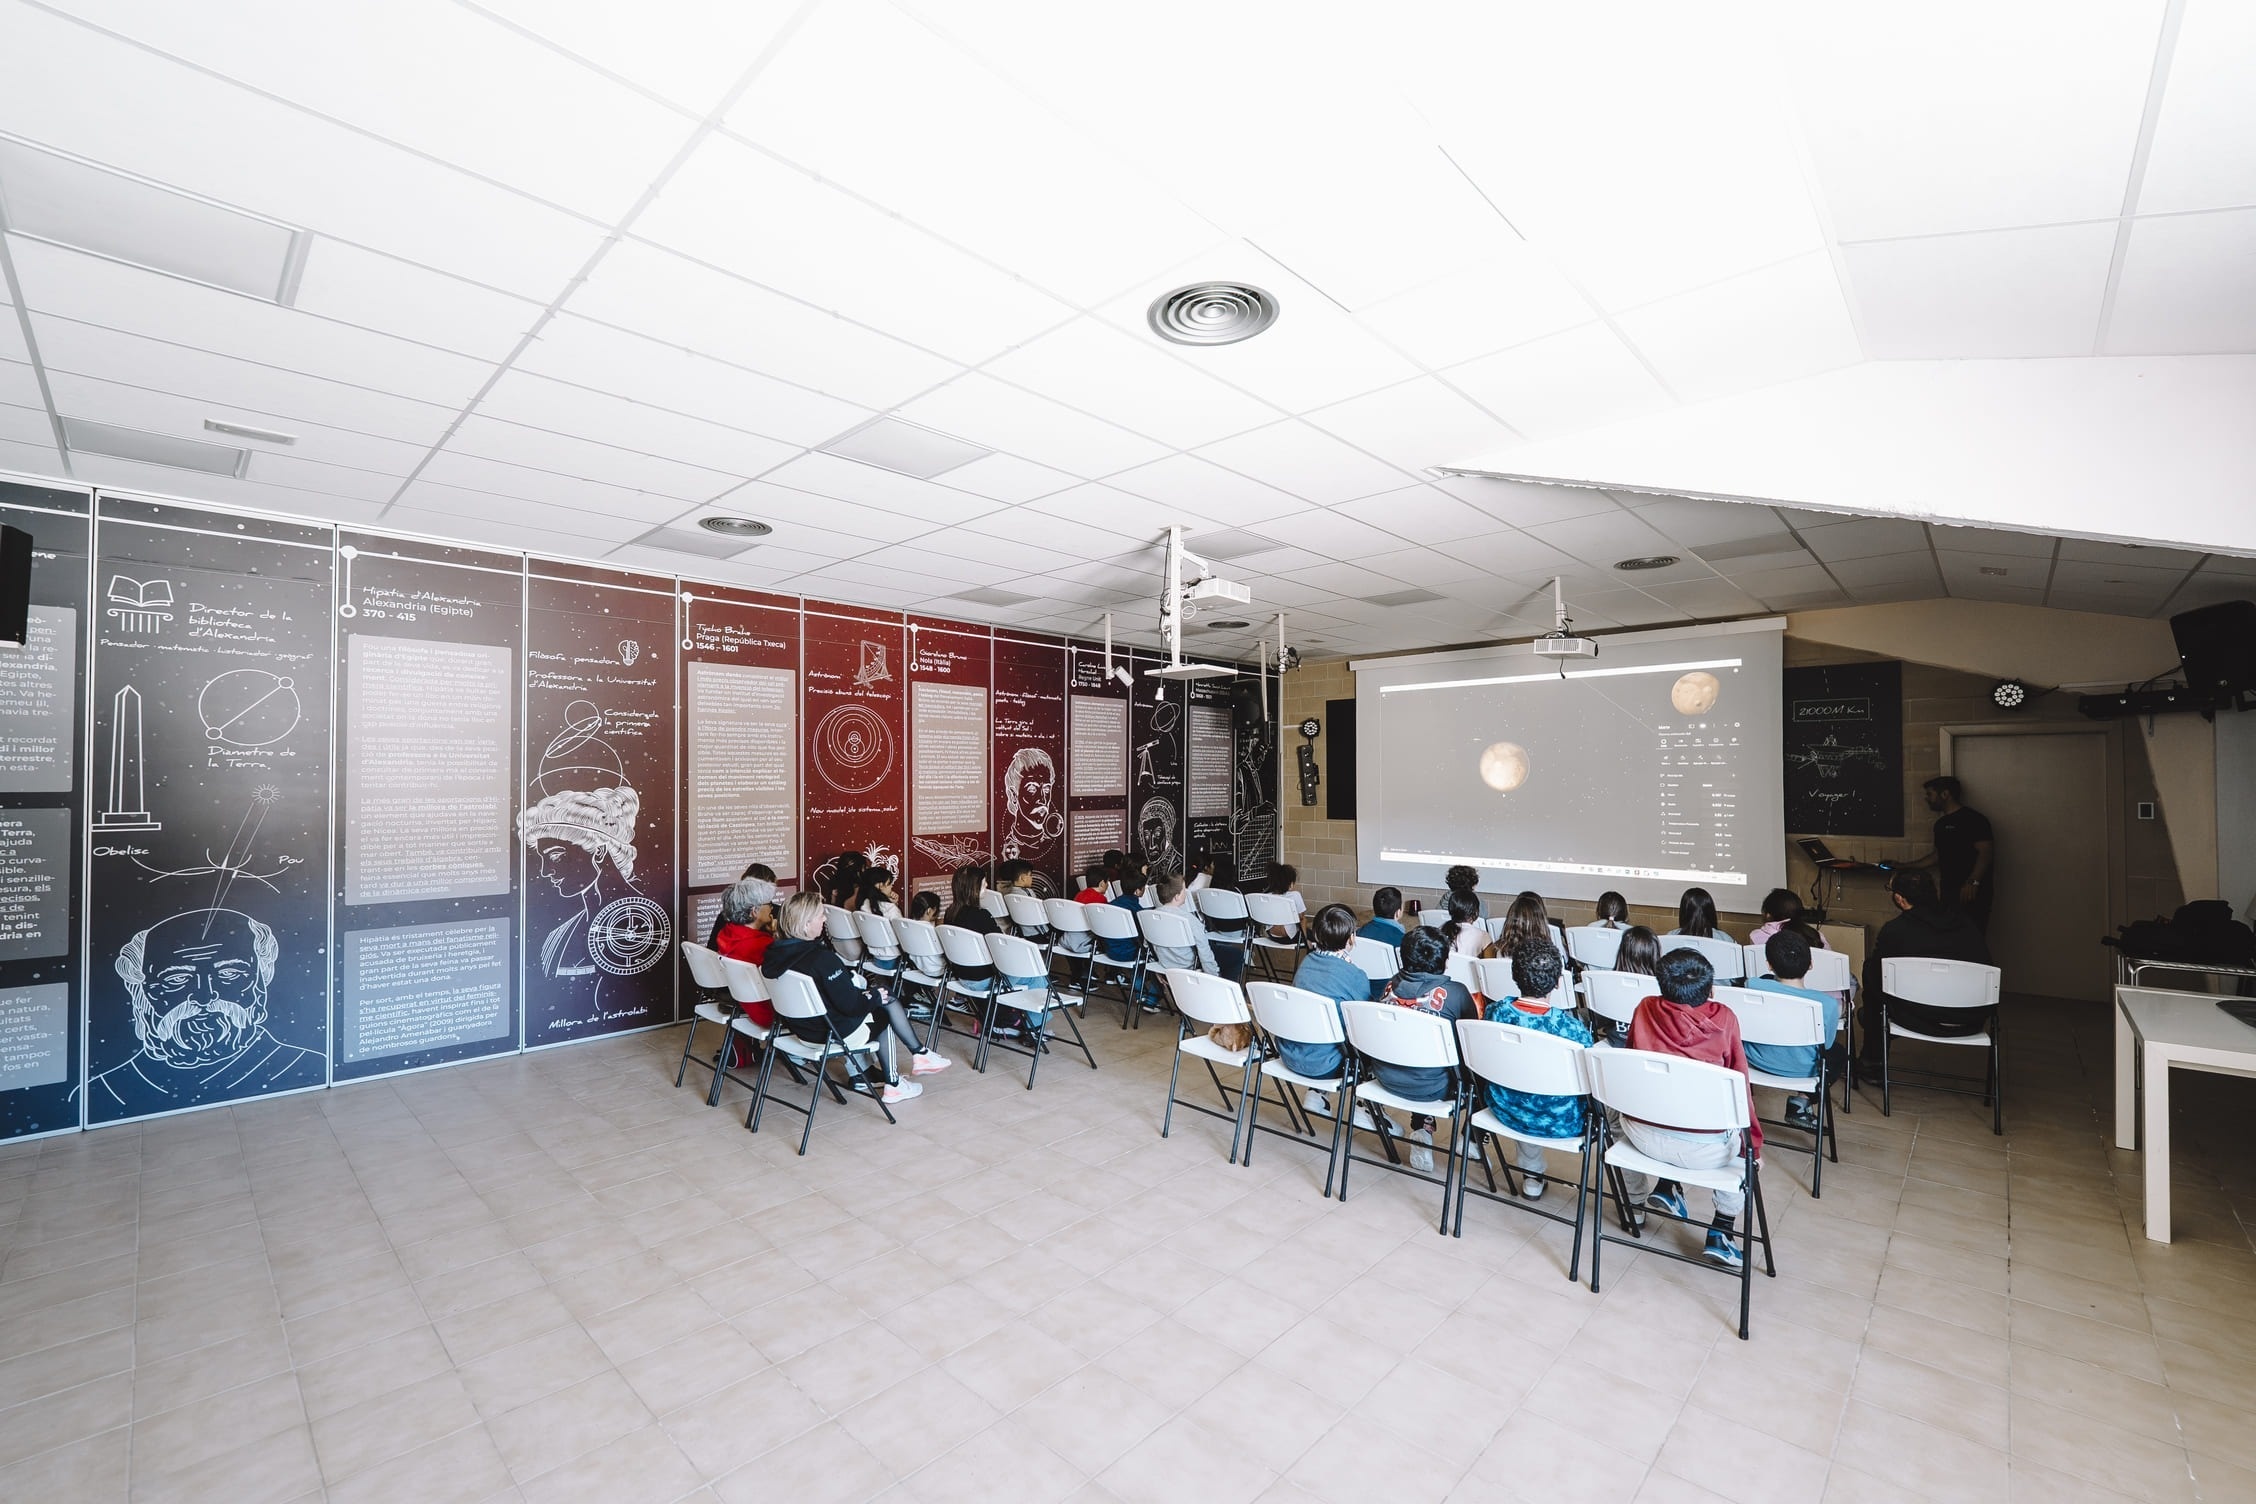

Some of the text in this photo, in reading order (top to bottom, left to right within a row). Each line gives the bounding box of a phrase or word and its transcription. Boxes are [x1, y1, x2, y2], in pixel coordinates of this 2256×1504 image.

[411, 590, 482, 607] d'Alexandria
[189, 602, 293, 621] Director de la
[363, 597, 474, 618] Alexandria (Egipte)
[363, 609, 417, 622] 370 415
[189, 615, 252, 629] biblioteca
[696, 623, 722, 634] Tycho
[189, 627, 277, 643] d'Alexandria
[100, 638, 150, 648] Pensador
[696, 632, 786, 650] Praga (República Txeca)
[696, 642, 739, 653] 1546 1601
[0, 662, 57, 670] lexandria,
[574, 656, 621, 666] pensadora
[937, 666, 951, 674] 1600
[529, 670, 583, 682] Professora
[596, 675, 604, 683] la
[607, 676, 657, 686] Universitat
[529, 680, 588, 691] d'Alexandria
[604, 709, 659, 720] Considerada
[604, 718, 651, 729] la primera
[8, 736, 57, 745] recordat
[20, 745, 55, 753] millor
[208, 745, 297, 757] Diametre de
[208, 757, 219, 768] la
[1808, 788, 1849, 802] Voyager
[93, 846, 150, 856] Obelisc
[279, 855, 304, 865] Pou
[7, 874, 55, 884] senzille-
[4, 913, 40, 921] tenint
[16, 921, 37, 929] dis-
[402, 931, 443, 939] tristament
[360, 973, 406, 982] inadvertida
[16, 996, 32, 1004] fer
[1429, 986, 1447, 1011] S
[9, 1004, 51, 1015] natura,
[360, 1021, 388, 1030] guions
[430, 1018, 453, 1027] (2009)
[455, 1014, 483, 1023] dirigida
[548, 1018, 583, 1030] Millora
[587, 1014, 600, 1023] de
[5, 1024, 37, 1034] certs,
[360, 1034, 399, 1045] Alejandro
[448, 1021, 492, 1032] guanyadora
[17, 1032, 53, 1041] vasta-
[372, 1040, 418, 1051] nombrosos
[5, 1050, 51, 1062] tampoc
[4, 1063, 21, 1071] fos
